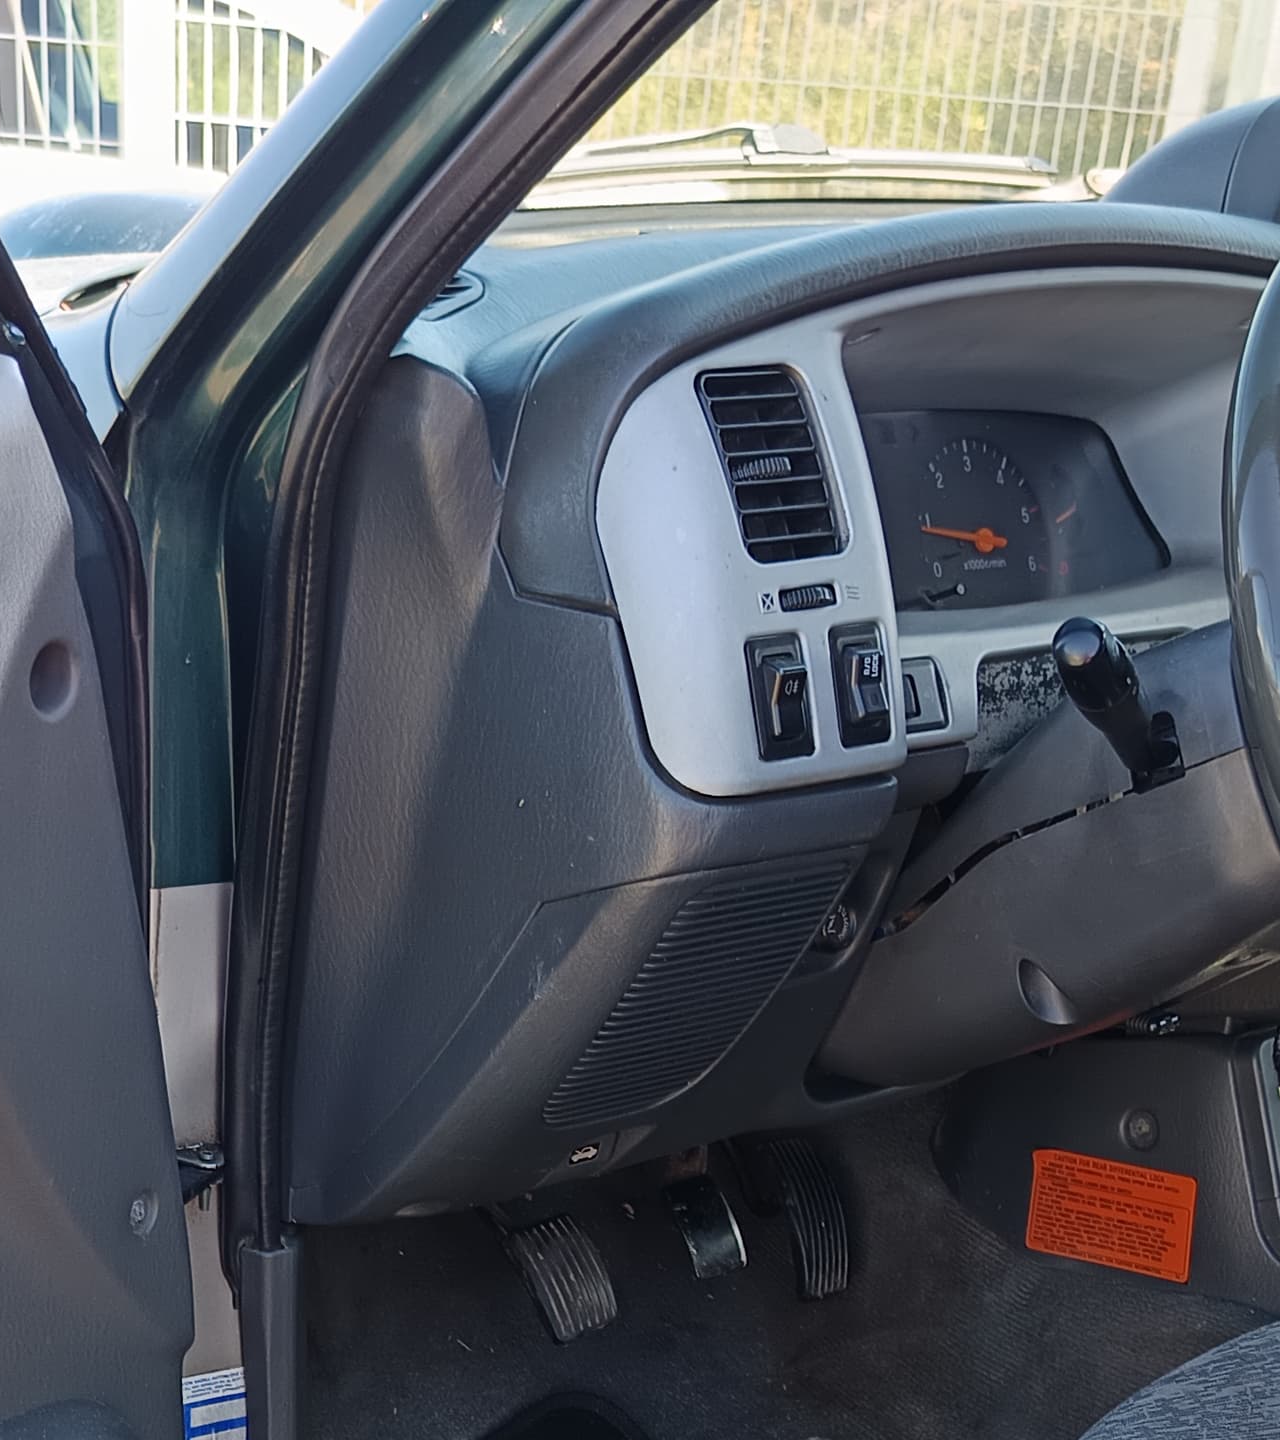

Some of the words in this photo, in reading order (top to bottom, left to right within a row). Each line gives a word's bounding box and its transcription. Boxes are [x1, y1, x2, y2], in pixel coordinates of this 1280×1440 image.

[962, 455, 972, 473] 3
[935, 471, 945, 489] 2
[996, 469, 1005, 485] 4
[1021, 507, 1030, 525] 5
[933, 561, 943, 578] 0
[1028, 556, 1037, 572] 6
[871, 653, 879, 677] LOCK
